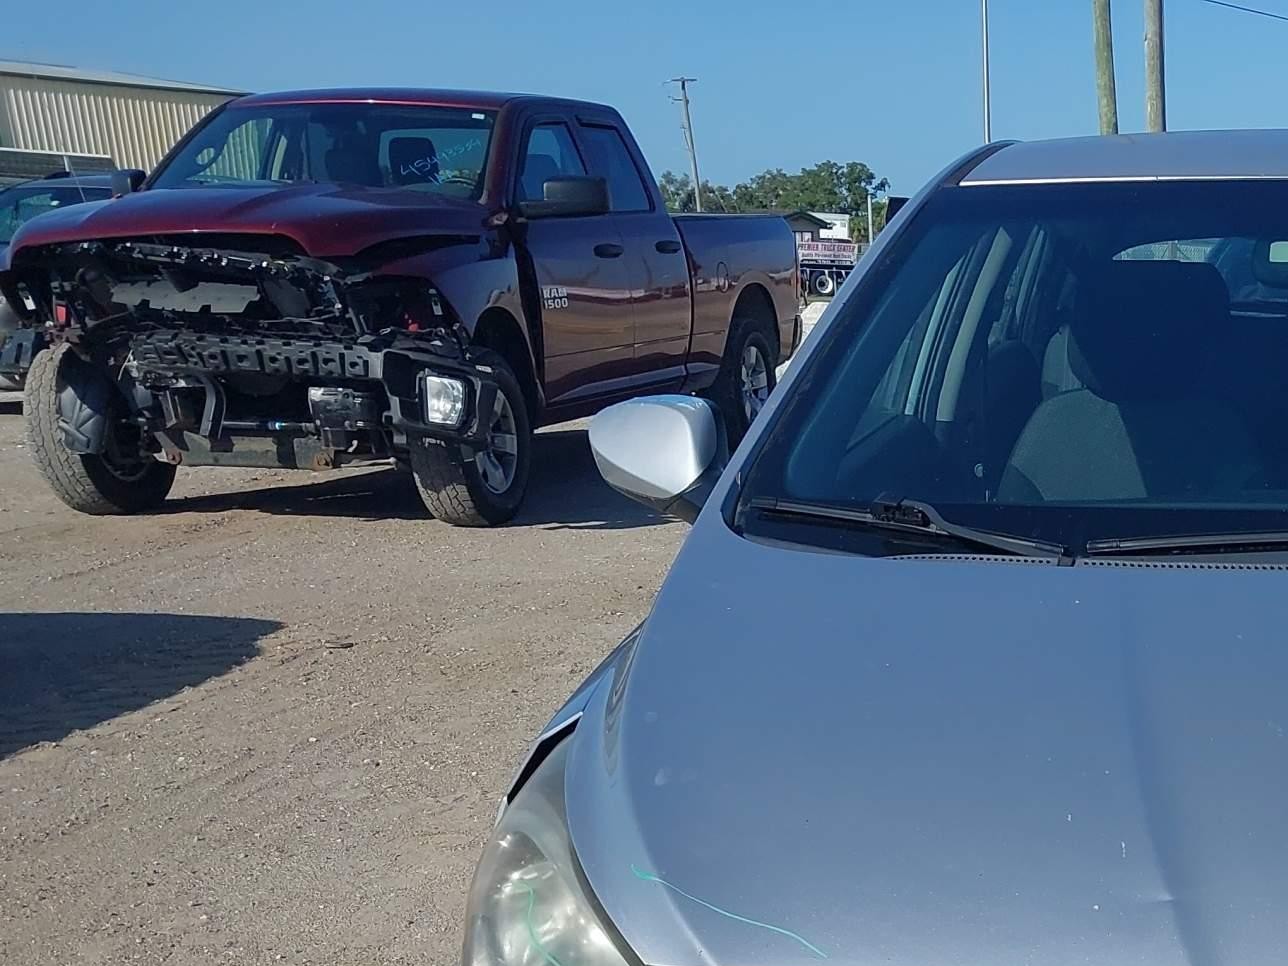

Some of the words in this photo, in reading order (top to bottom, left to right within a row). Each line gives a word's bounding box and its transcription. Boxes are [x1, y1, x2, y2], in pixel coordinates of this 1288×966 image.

[837, 244, 856, 253] CENTER
[542, 287, 568, 298] RAM
[543, 297, 569, 310] 1500
